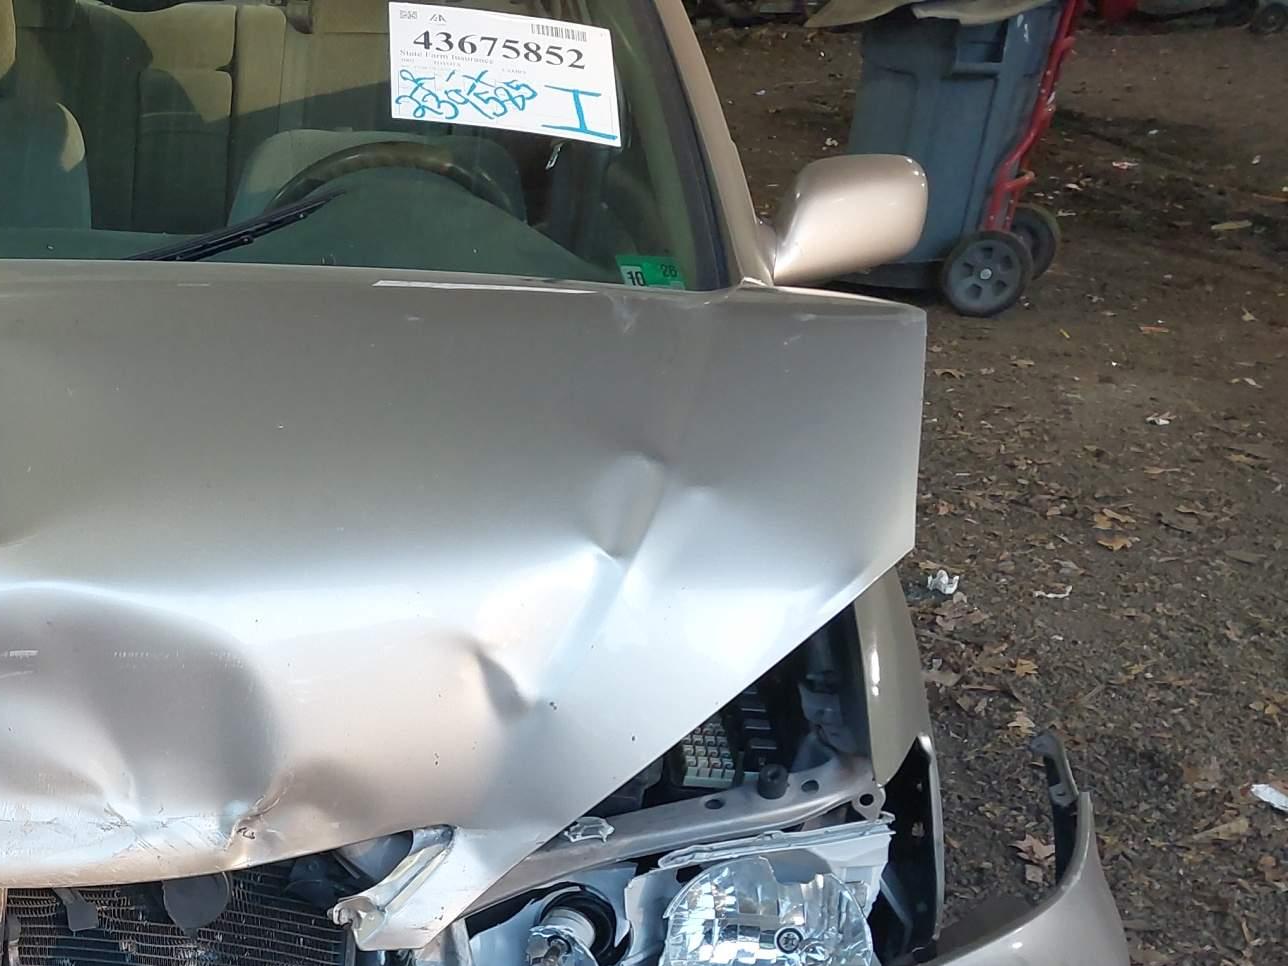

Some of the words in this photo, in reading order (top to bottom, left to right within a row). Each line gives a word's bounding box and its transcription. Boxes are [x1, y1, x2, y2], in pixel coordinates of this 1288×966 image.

[399, 49, 423, 58] State
[425, 51, 449, 60] Farm
[413, 29, 586, 70] 43675852
[626, 270, 646, 287] 10
